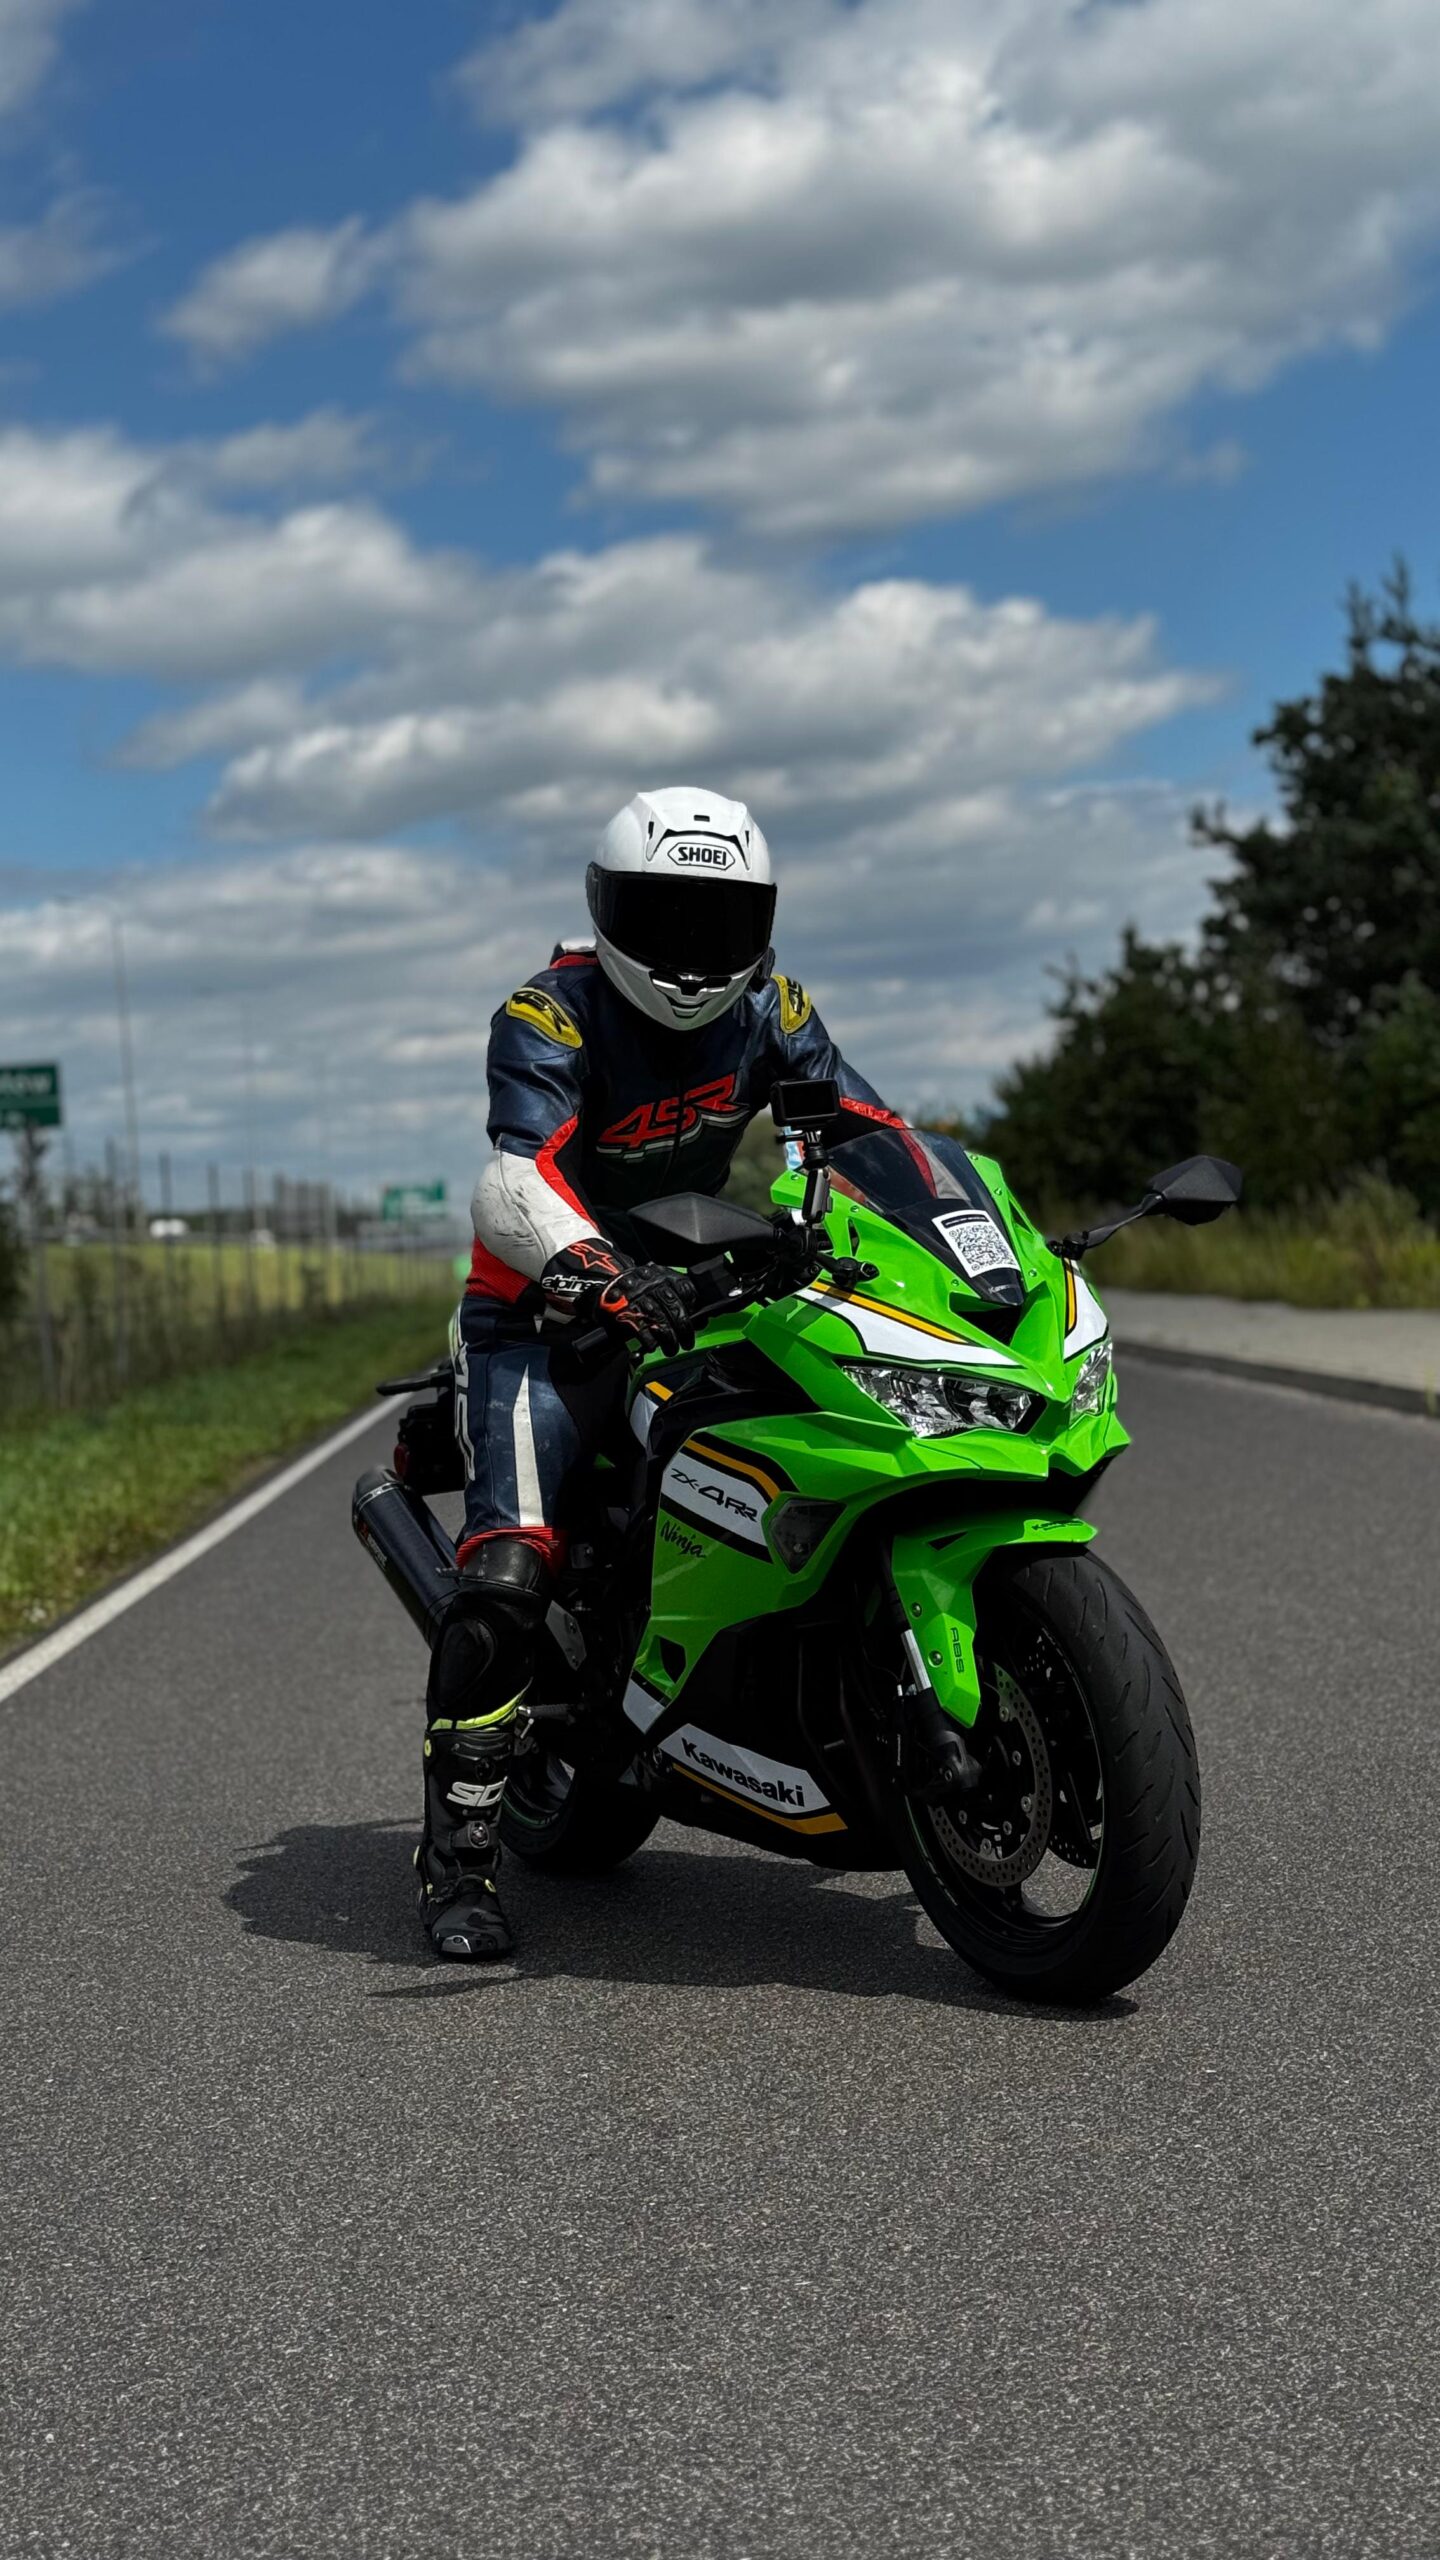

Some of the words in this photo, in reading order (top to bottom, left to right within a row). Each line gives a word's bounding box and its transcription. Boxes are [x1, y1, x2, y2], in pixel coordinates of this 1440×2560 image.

[678, 846, 727, 866] SHOEI
[598, 1072, 742, 1149] 4SR
[670, 1468, 758, 1523] ZX-4RR
[661, 1520, 706, 1558] Ninja
[950, 1627, 965, 1674] ABS
[681, 1737, 805, 1807] Kawasaki
